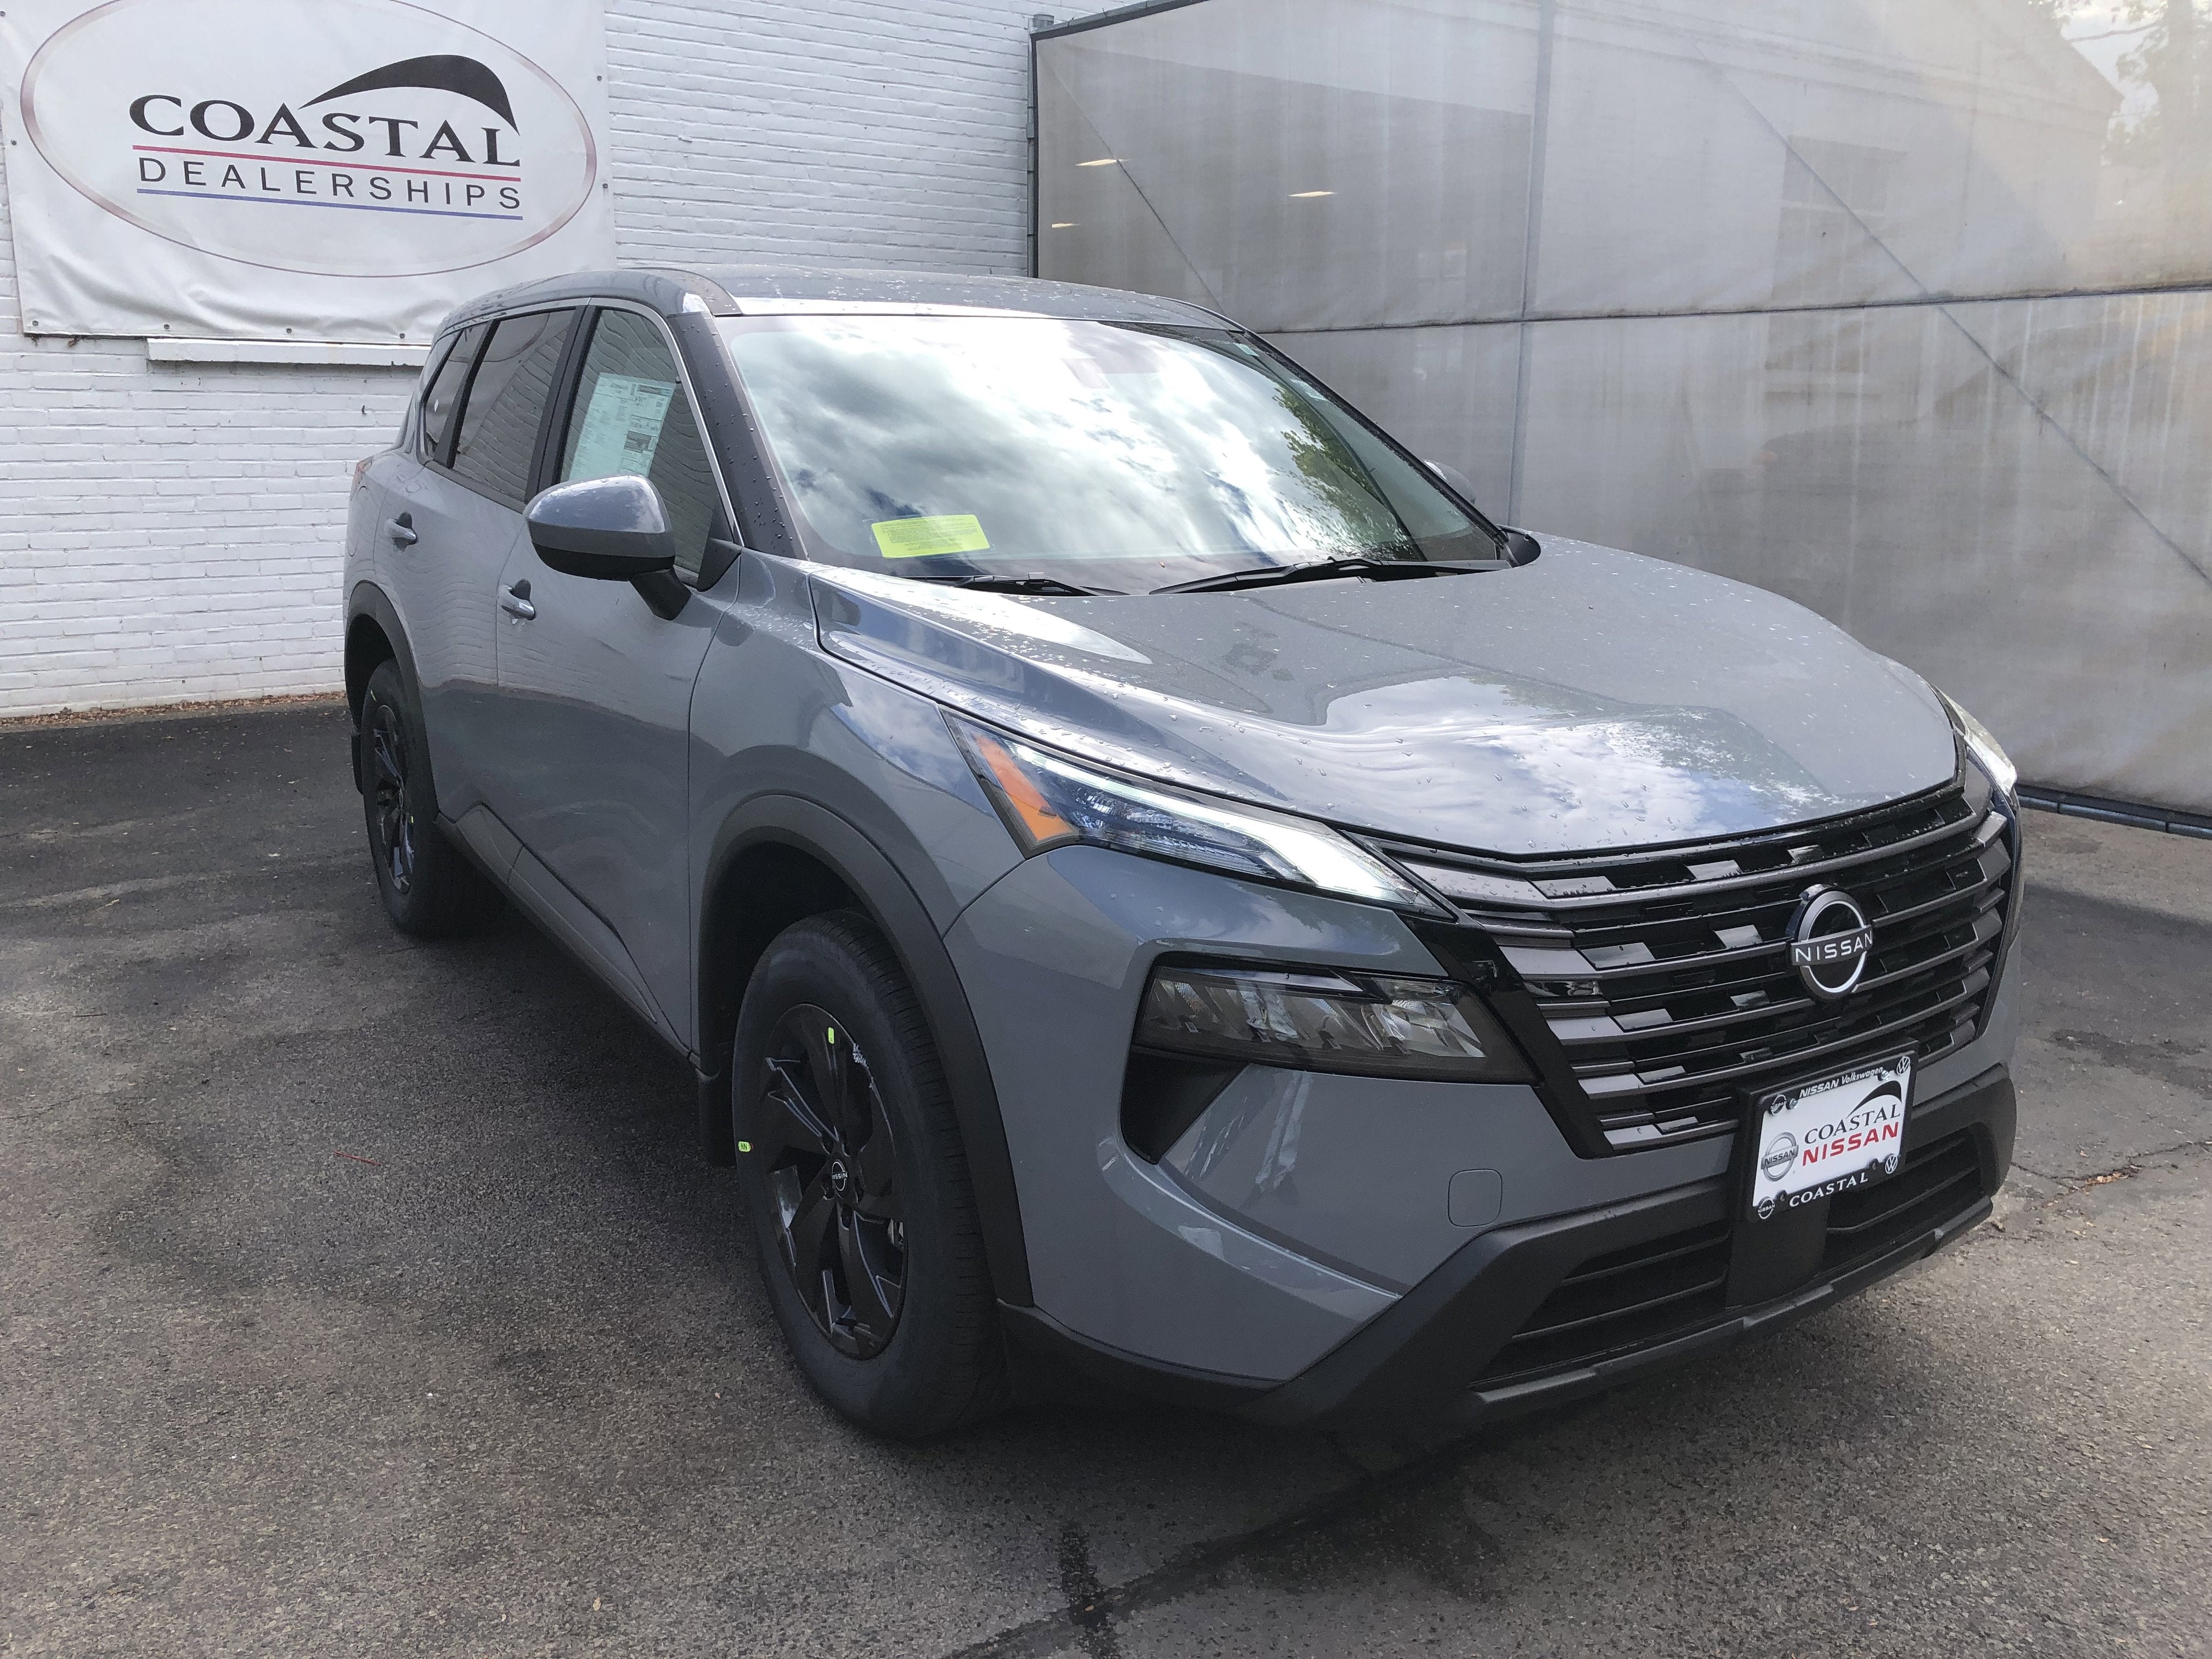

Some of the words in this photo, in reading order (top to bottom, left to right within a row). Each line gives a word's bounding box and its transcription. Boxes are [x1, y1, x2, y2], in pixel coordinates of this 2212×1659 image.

[129, 94, 520, 167] COASTAL
[139, 157, 521, 210] DEALERSHIPS
[1795, 930, 1872, 962] NISSAN
[1799, 1079, 1839, 1098] NISSAN
[1841, 1066, 1883, 1085] Volkswagen
[1804, 1104, 1900, 1144] COASTAL
[1764, 1149, 1795, 1166] NISSAN
[1802, 1121, 1899, 1167] NISSAN
[1790, 1172, 1869, 1207] COASTAL
